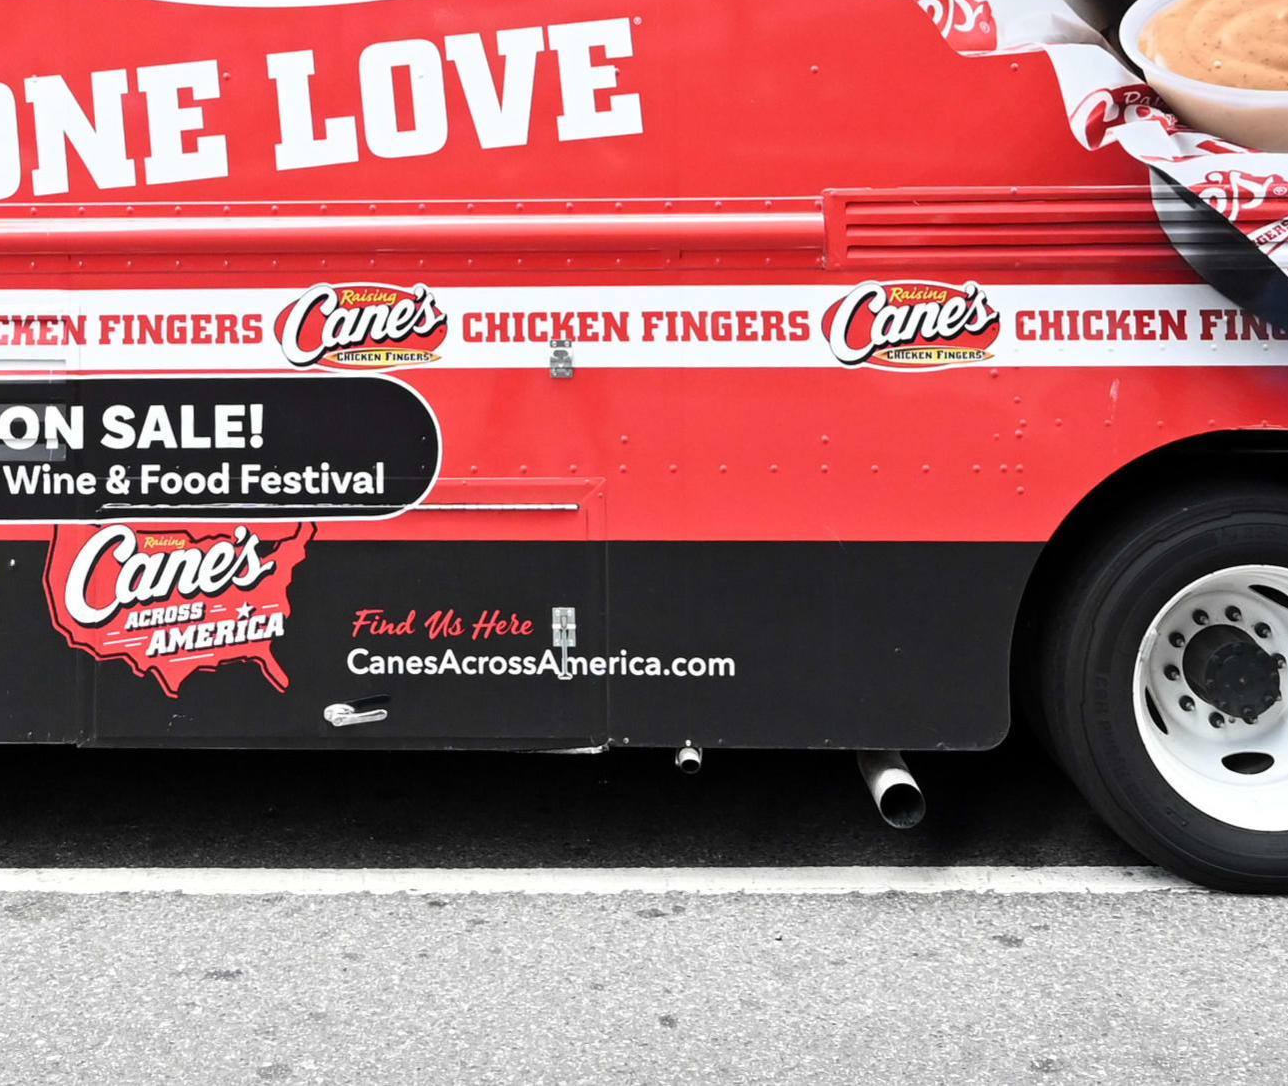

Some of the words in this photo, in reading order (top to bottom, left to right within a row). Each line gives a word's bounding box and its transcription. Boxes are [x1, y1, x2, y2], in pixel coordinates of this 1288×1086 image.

[341, 289, 397, 307] Raising
[891, 286, 947, 305] Raising
[99, 314, 263, 345] FINGERS
[280, 284, 445, 368] Cane's
[463, 312, 633, 342] CHICKEN
[642, 311, 810, 341] FINGERS
[830, 280, 999, 366] Cane's
[1016, 310, 1188, 341] CHICKEN
[337, 353, 382, 363] CHICKEN
[384, 352, 430, 362] FINGERS
[887, 350, 932, 361] CHICKEN
[936, 349, 983, 360] FINGERS
[101, 403, 263, 449] SALE!
[3, 463, 99, 495] Wine
[104, 464, 129, 495] &
[137, 462, 230, 495] Food
[239, 462, 385, 495] Festival
[144, 535, 186, 549] Raising
[65, 524, 276, 628] Cane's
[125, 602, 205, 631] ACROSS
[351, 609, 415, 638] Find
[425, 611, 465, 639] Us
[472, 611, 534, 641] Here
[146, 612, 285, 657] AMERICA
[347, 648, 736, 678] CanesAcrossAmerica.com
